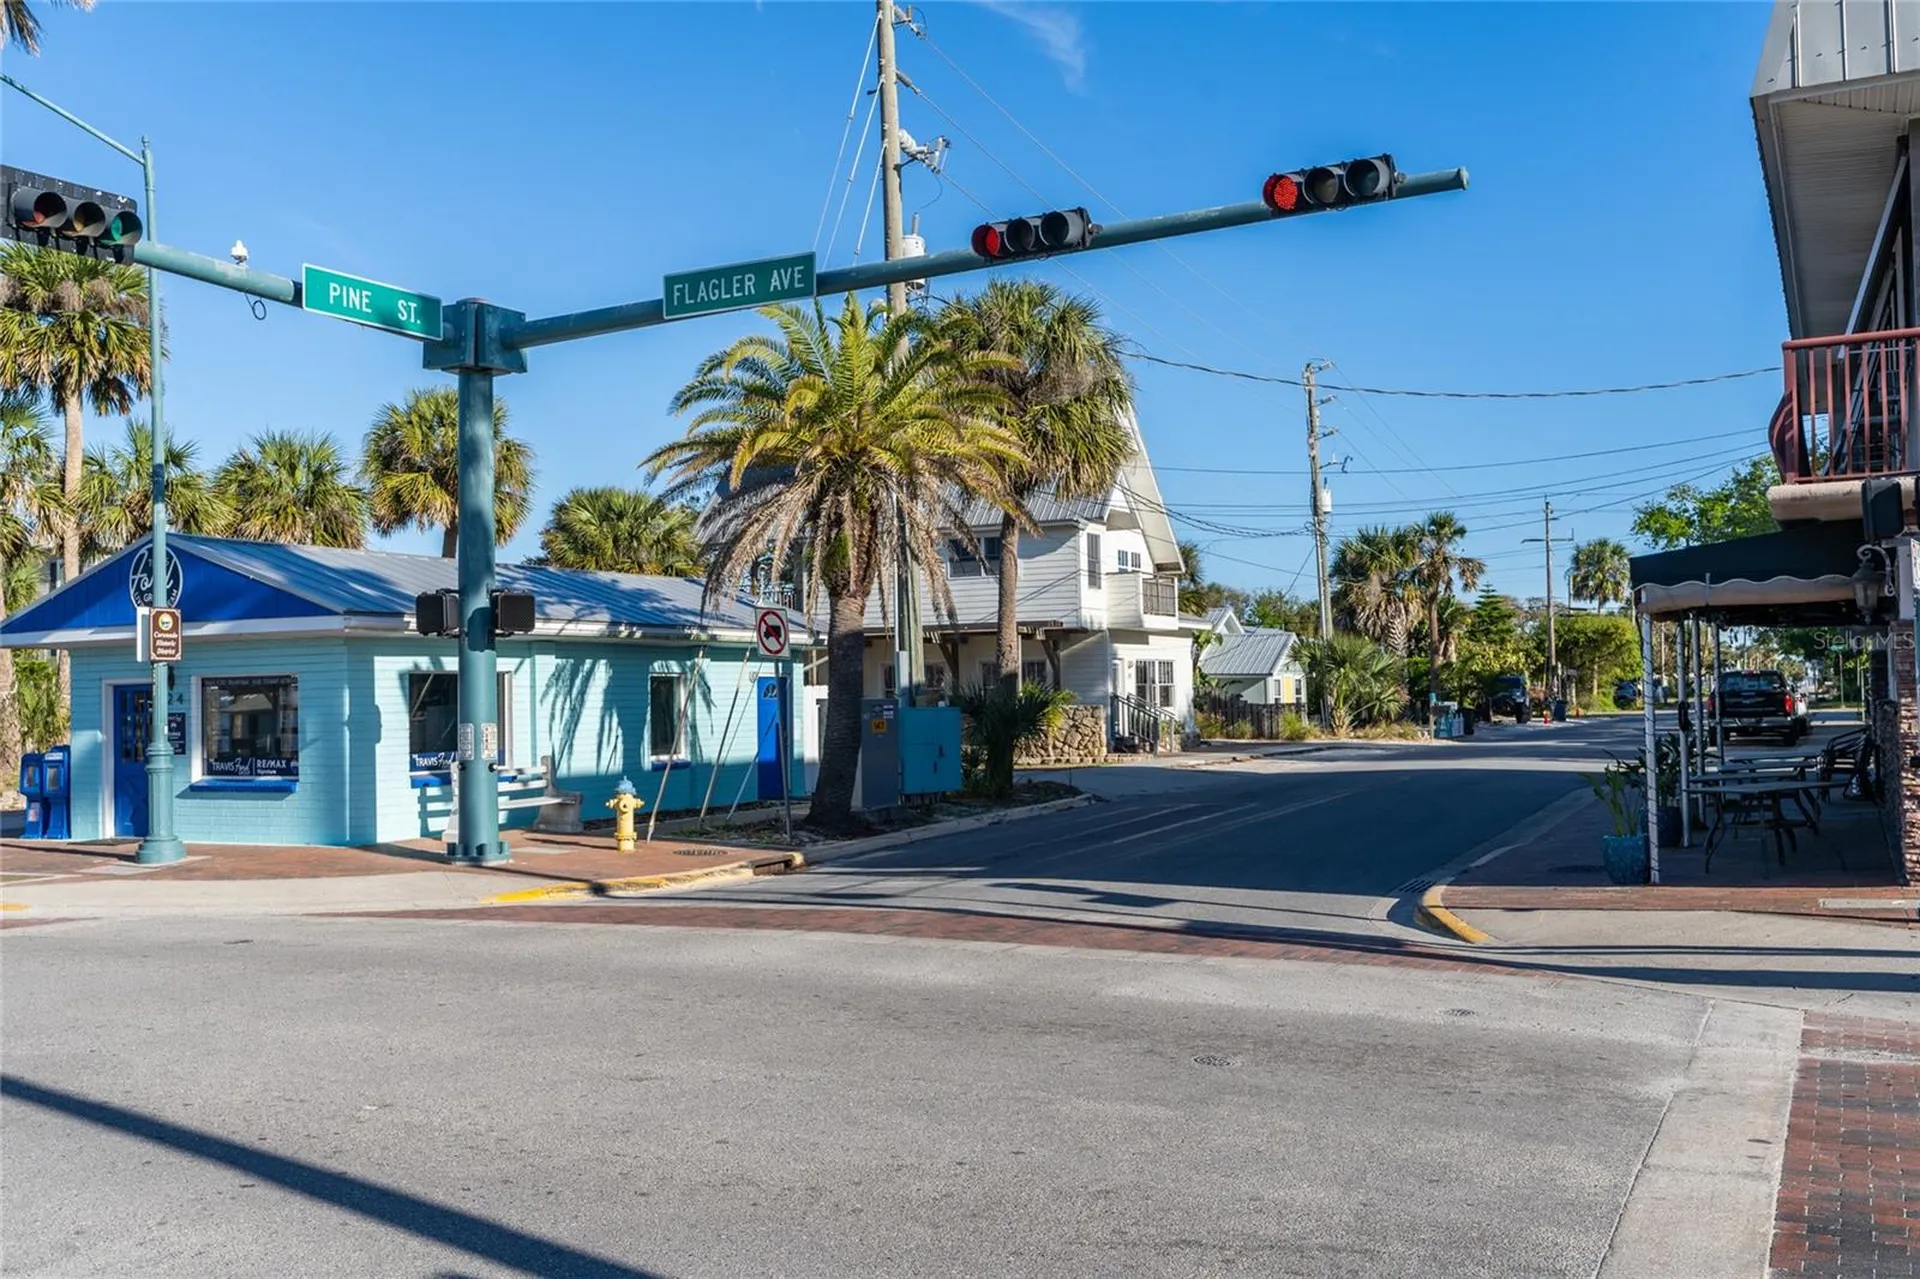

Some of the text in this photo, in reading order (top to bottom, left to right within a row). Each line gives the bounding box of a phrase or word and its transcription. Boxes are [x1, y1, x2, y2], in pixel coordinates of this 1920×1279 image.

[328, 281, 421, 325] PINE ST.
[673, 265, 805, 307] FLAGLER AVE
[131, 548, 174, 591] Fod
[211, 761, 235, 772] TRAVIS
[256, 758, 287, 769] RE/MAX
[415, 756, 438, 767] TRAVIS
